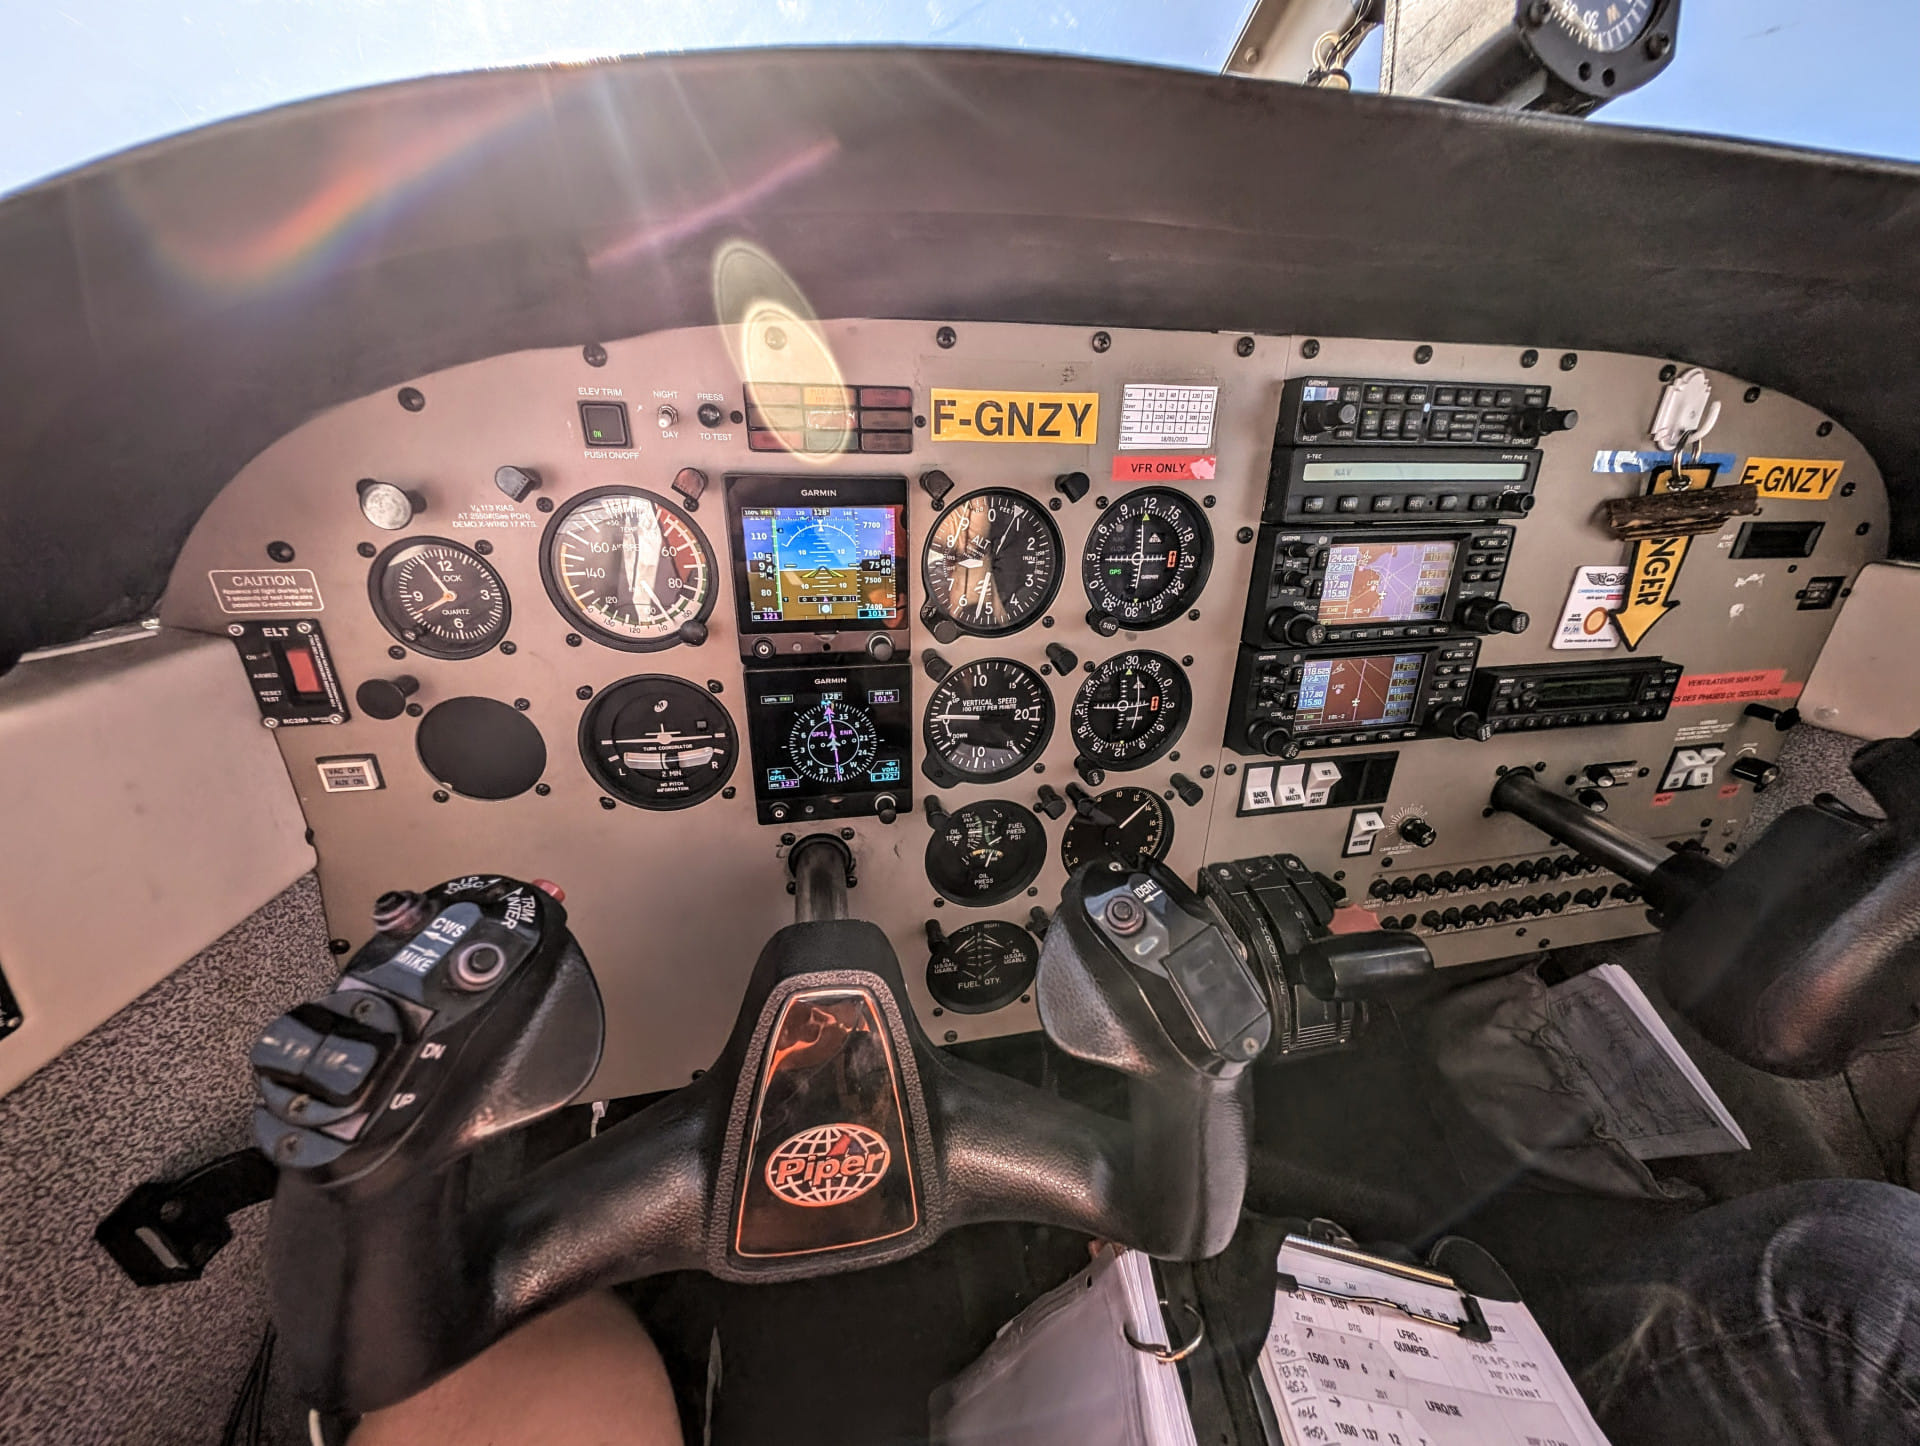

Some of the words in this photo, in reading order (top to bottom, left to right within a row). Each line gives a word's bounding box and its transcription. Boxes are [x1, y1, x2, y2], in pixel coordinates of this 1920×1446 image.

[578, 387, 599, 395] ELEV
[601, 388, 622, 396] TRIM
[653, 391, 678, 399] NIGHT
[934, 399, 1093, 437] F-GNZY
[584, 451, 607, 459] PUSH
[1131, 464, 1152, 472] VFR
[1156, 464, 1186, 473] ONLY
[1120, 504, 1128, 515] 9
[1143, 498, 1156, 509] 12
[988, 509, 996, 522] 0
[1168, 505, 1181, 520] 15
[961, 518, 969, 530] 9
[1098, 525, 1107, 534] 6
[1183, 526, 1194, 542] 18
[947, 535, 955, 548] 8
[971, 535, 991, 549] ALT
[1027, 538, 1035, 551] 2
[590, 543, 609, 553] 160
[661, 547, 677, 557] 60
[1086, 553, 1096, 561] 3
[1184, 556, 1195, 569] 21
[437, 561, 454, 572] 12
[1635, 538, 1679, 606] NGER
[585, 568, 605, 578] 140
[232, 575, 296, 586] CAUTION
[668, 578, 682, 589] 80
[947, 578, 954, 591] 7
[1025, 574, 1034, 587] 3
[1172, 580, 1184, 595] 24
[413, 591, 423, 602] 9
[480, 590, 490, 600] 3
[605, 596, 617, 604] 120
[959, 595, 968, 606] 6
[1010, 594, 1019, 605] 4
[985, 602, 993, 614] 5
[1102, 599, 1116, 612] 33
[1151, 600, 1163, 614] 27
[763, 612, 779, 620] 121
[1125, 607, 1139, 617] 30
[454, 618, 464, 628] 6
[262, 628, 290, 637] ELT
[629, 626, 641, 634] 120
[1126, 656, 1138, 666] 30
[1148, 660, 1160, 672] 33
[974, 675, 987, 687] 10
[1014, 709, 1029, 720] 20
[1075, 704, 1084, 715] 21
[1077, 725, 1088, 738] 18
[972, 746, 985, 758] 10
[1114, 748, 1126, 757] 12
[619, 768, 627, 776] L
[1133, 880, 1157, 898] IDENT
[501, 897, 520, 929] INTER
[520, 896, 535, 923] TRIM
[432, 918, 466, 937] CWS
[398, 950, 435, 973] MIKE
[958, 980, 979, 989] FUEL
[420, 1043, 446, 1059] DN
[390, 1093, 416, 1110] UP
[776, 1151, 886, 1187] Piper
[1330, 1298, 1349, 1310] DIST
[1359, 1305, 1374, 1316] TSV
[1394, 1340, 1431, 1358] QUIMPER
[1308, 1352, 1329, 1365] 1500
[1333, 1358, 1350, 1370] 159
[1335, 1422, 1358, 1437] 1500
[1362, 1429, 1378, 1440] 137
